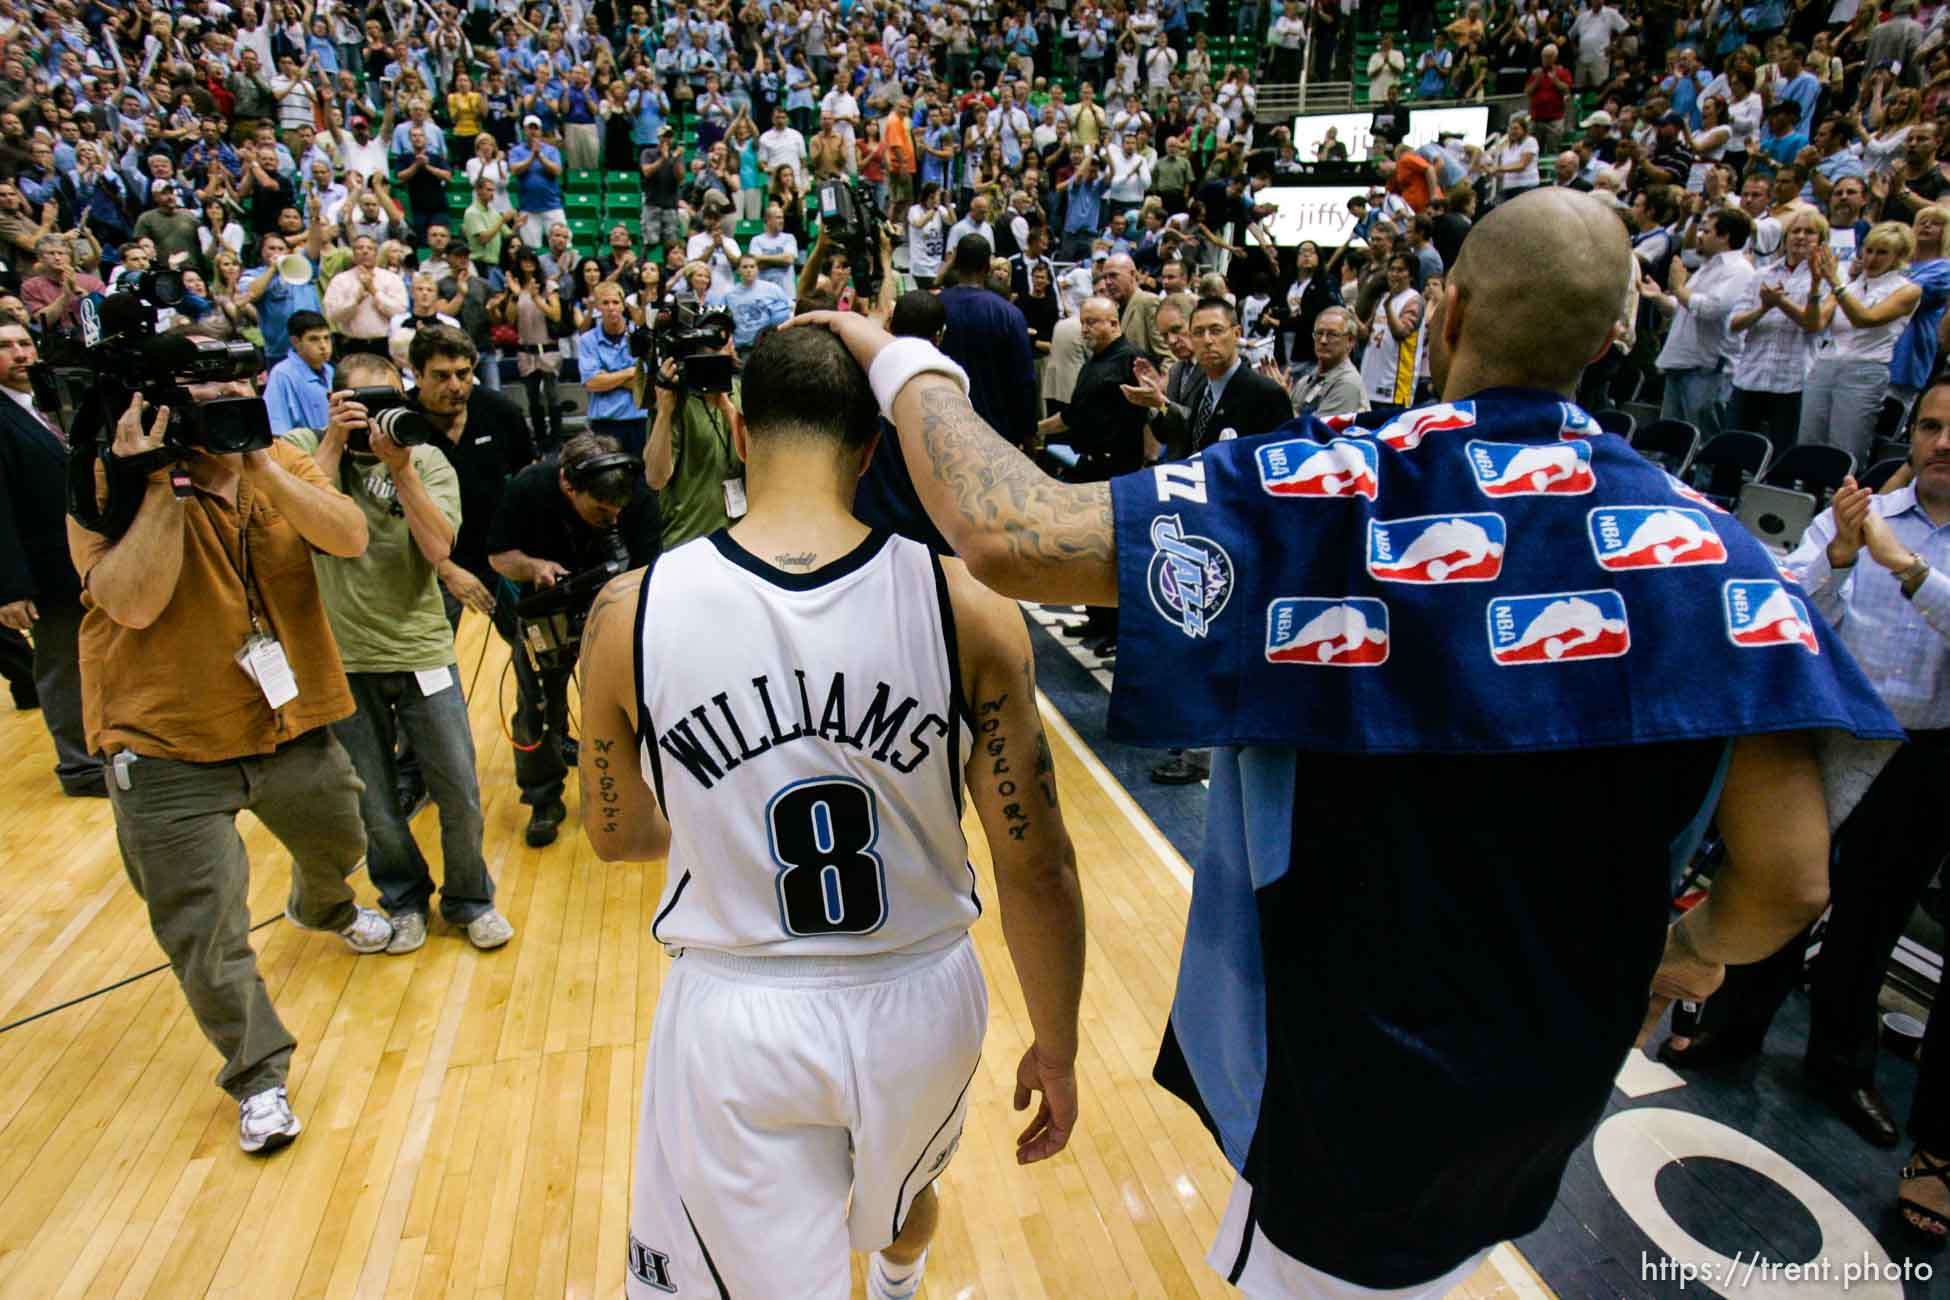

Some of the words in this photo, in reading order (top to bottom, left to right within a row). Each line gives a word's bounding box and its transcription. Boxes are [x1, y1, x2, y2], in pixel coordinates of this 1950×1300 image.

[1296, 203, 1350, 232] jiffy
[1154, 453, 1207, 504] ZZ
[1266, 447, 1291, 478] NBA
[1472, 447, 1499, 480] NBA
[1373, 527, 1394, 564] NBA
[1598, 514, 1624, 550] NBA
[1275, 606, 1293, 643] NBA
[1495, 605, 1517, 642] NBA
[1732, 587, 1751, 625] NBA
[659, 669, 949, 790] WILLIAMS
[766, 774, 889, 937] 8
